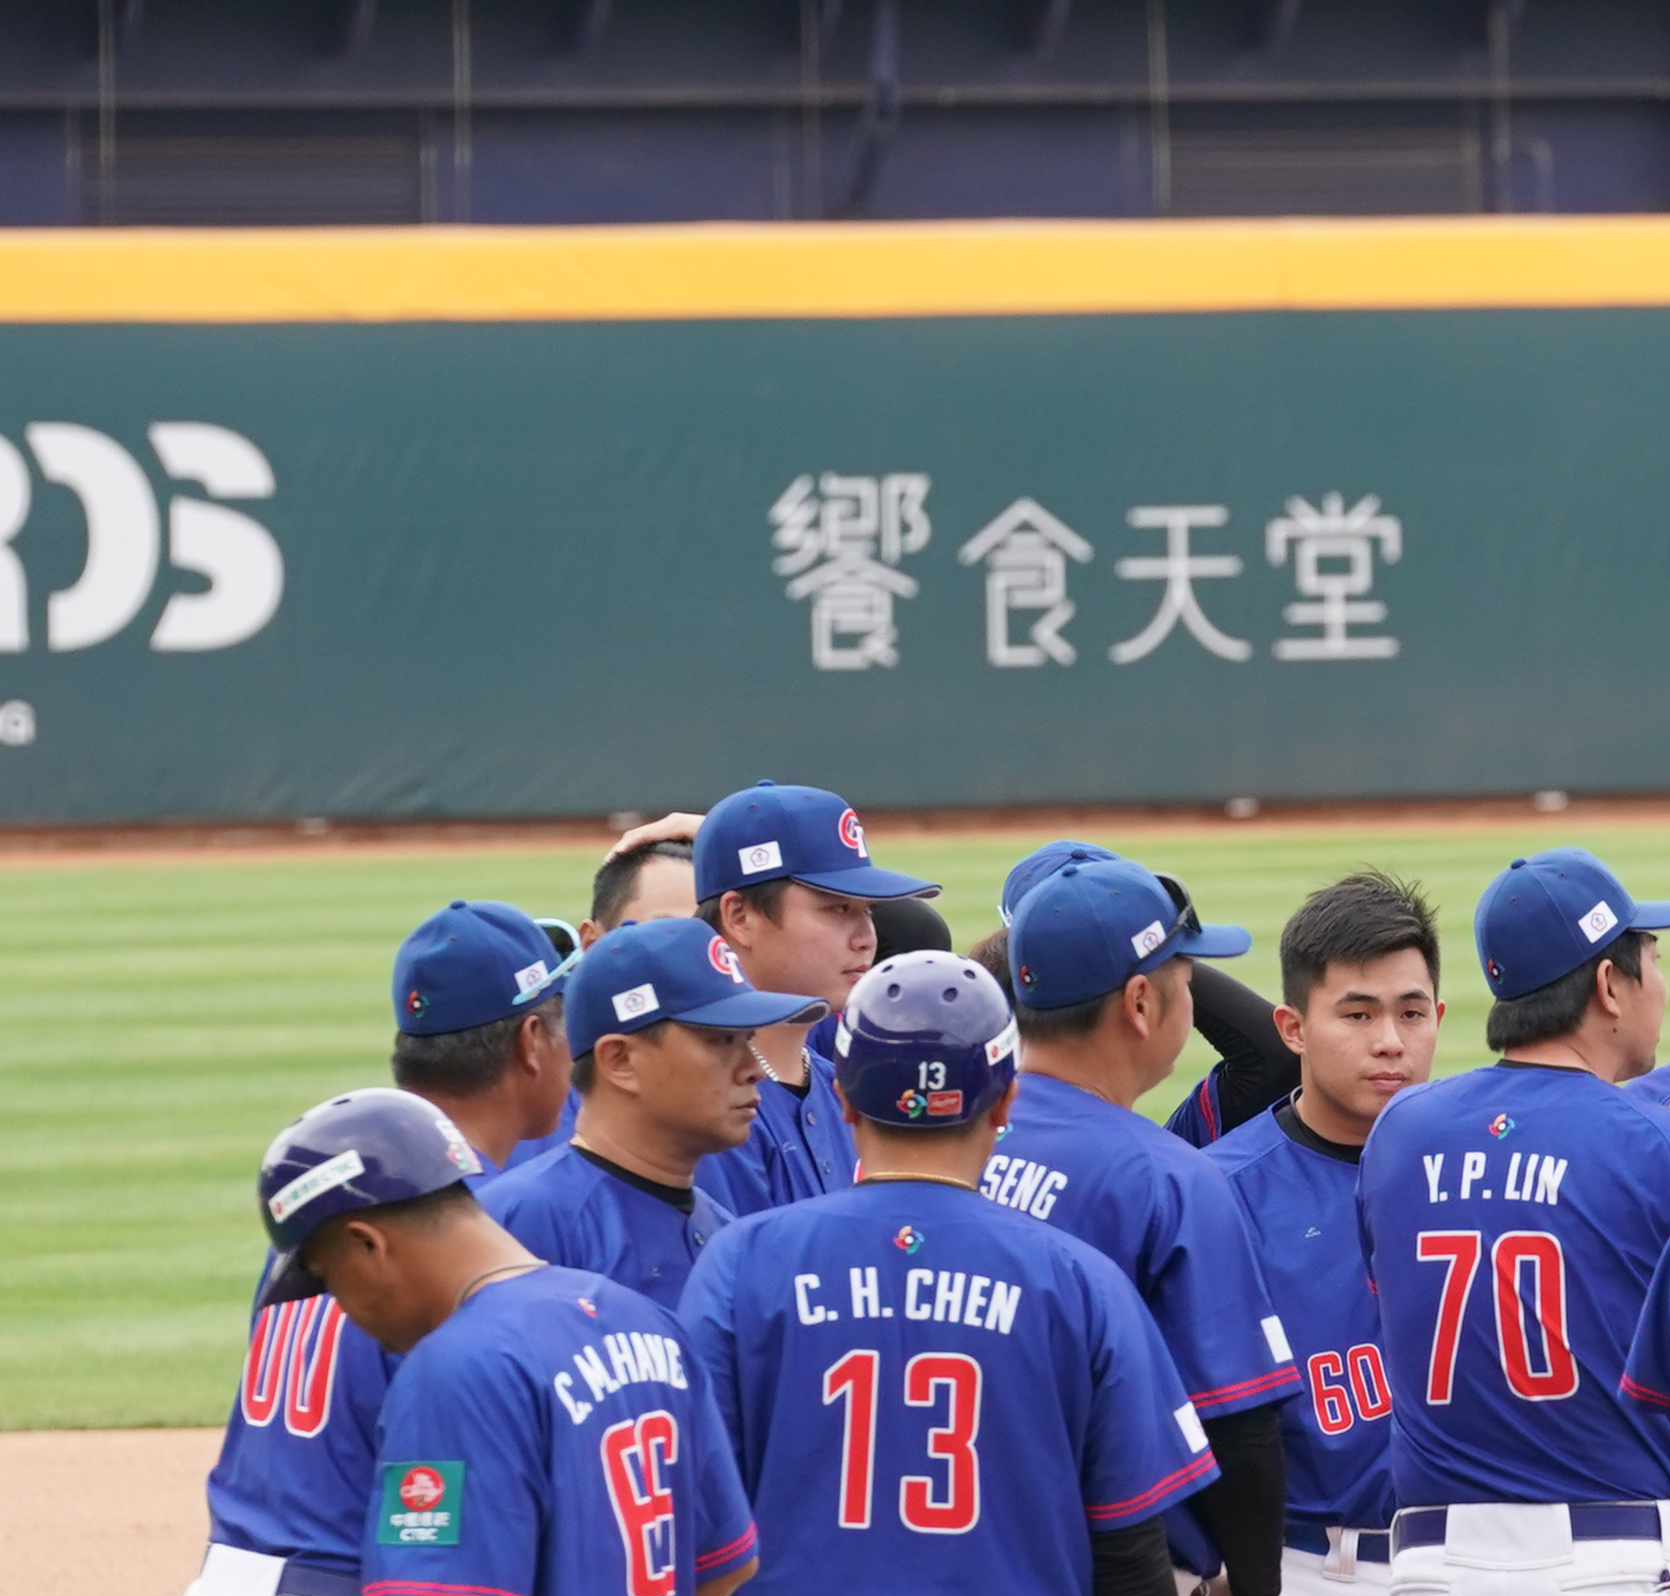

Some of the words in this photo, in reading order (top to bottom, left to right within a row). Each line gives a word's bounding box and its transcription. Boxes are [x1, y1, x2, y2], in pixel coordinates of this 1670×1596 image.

[0, 421, 284, 652] DS
[768, 472, 1402, 670] 饗食天堂
[918, 1061, 947, 1090] 13
[1422, 1153, 1448, 1203] Y.
[1460, 1151, 1492, 1201] P.
[1504, 1151, 1569, 1207] LIN
[795, 1274, 838, 1325] C.
[850, 1267, 894, 1318] H.
[904, 1268, 1022, 1335] CHEN
[1416, 1229, 1580, 1406] 70
[553, 1370, 594, 1426] C.
[1308, 1343, 1393, 1436] 60
[822, 1348, 983, 1535] 13
